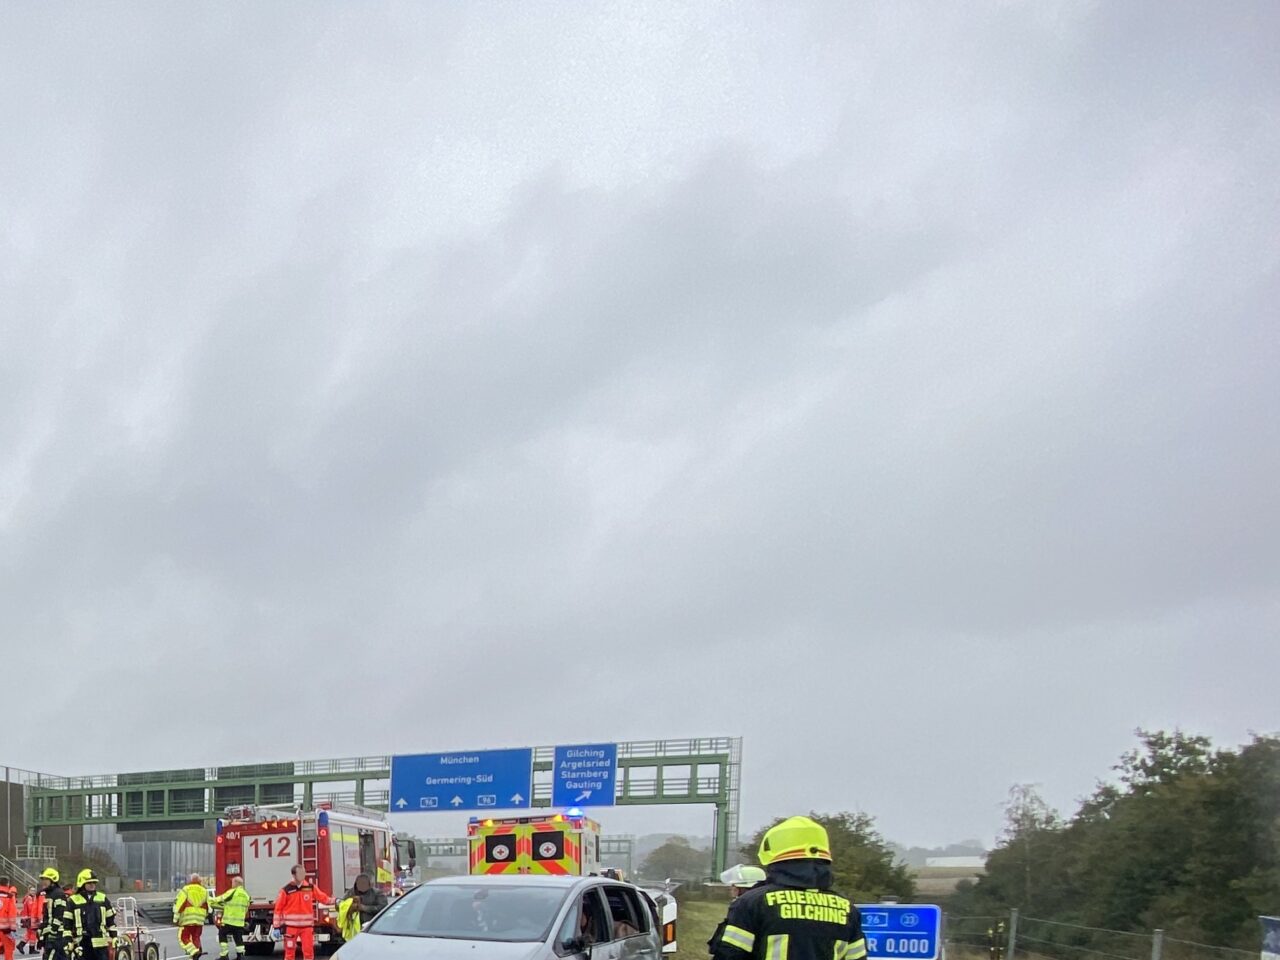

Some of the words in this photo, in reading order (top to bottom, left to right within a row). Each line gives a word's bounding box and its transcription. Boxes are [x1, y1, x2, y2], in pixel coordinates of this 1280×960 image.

[566, 749, 605, 759] Gilching
[440, 755, 480, 765] München
[560, 758, 611, 770] Argelsried
[425, 774, 494, 785] Germering-Süd
[560, 770, 609, 779] Starnberg
[565, 780, 603, 790] Gauting
[249, 836, 291, 859] 112
[780, 904, 847, 925] GILCHING
[866, 915, 880, 924] 96
